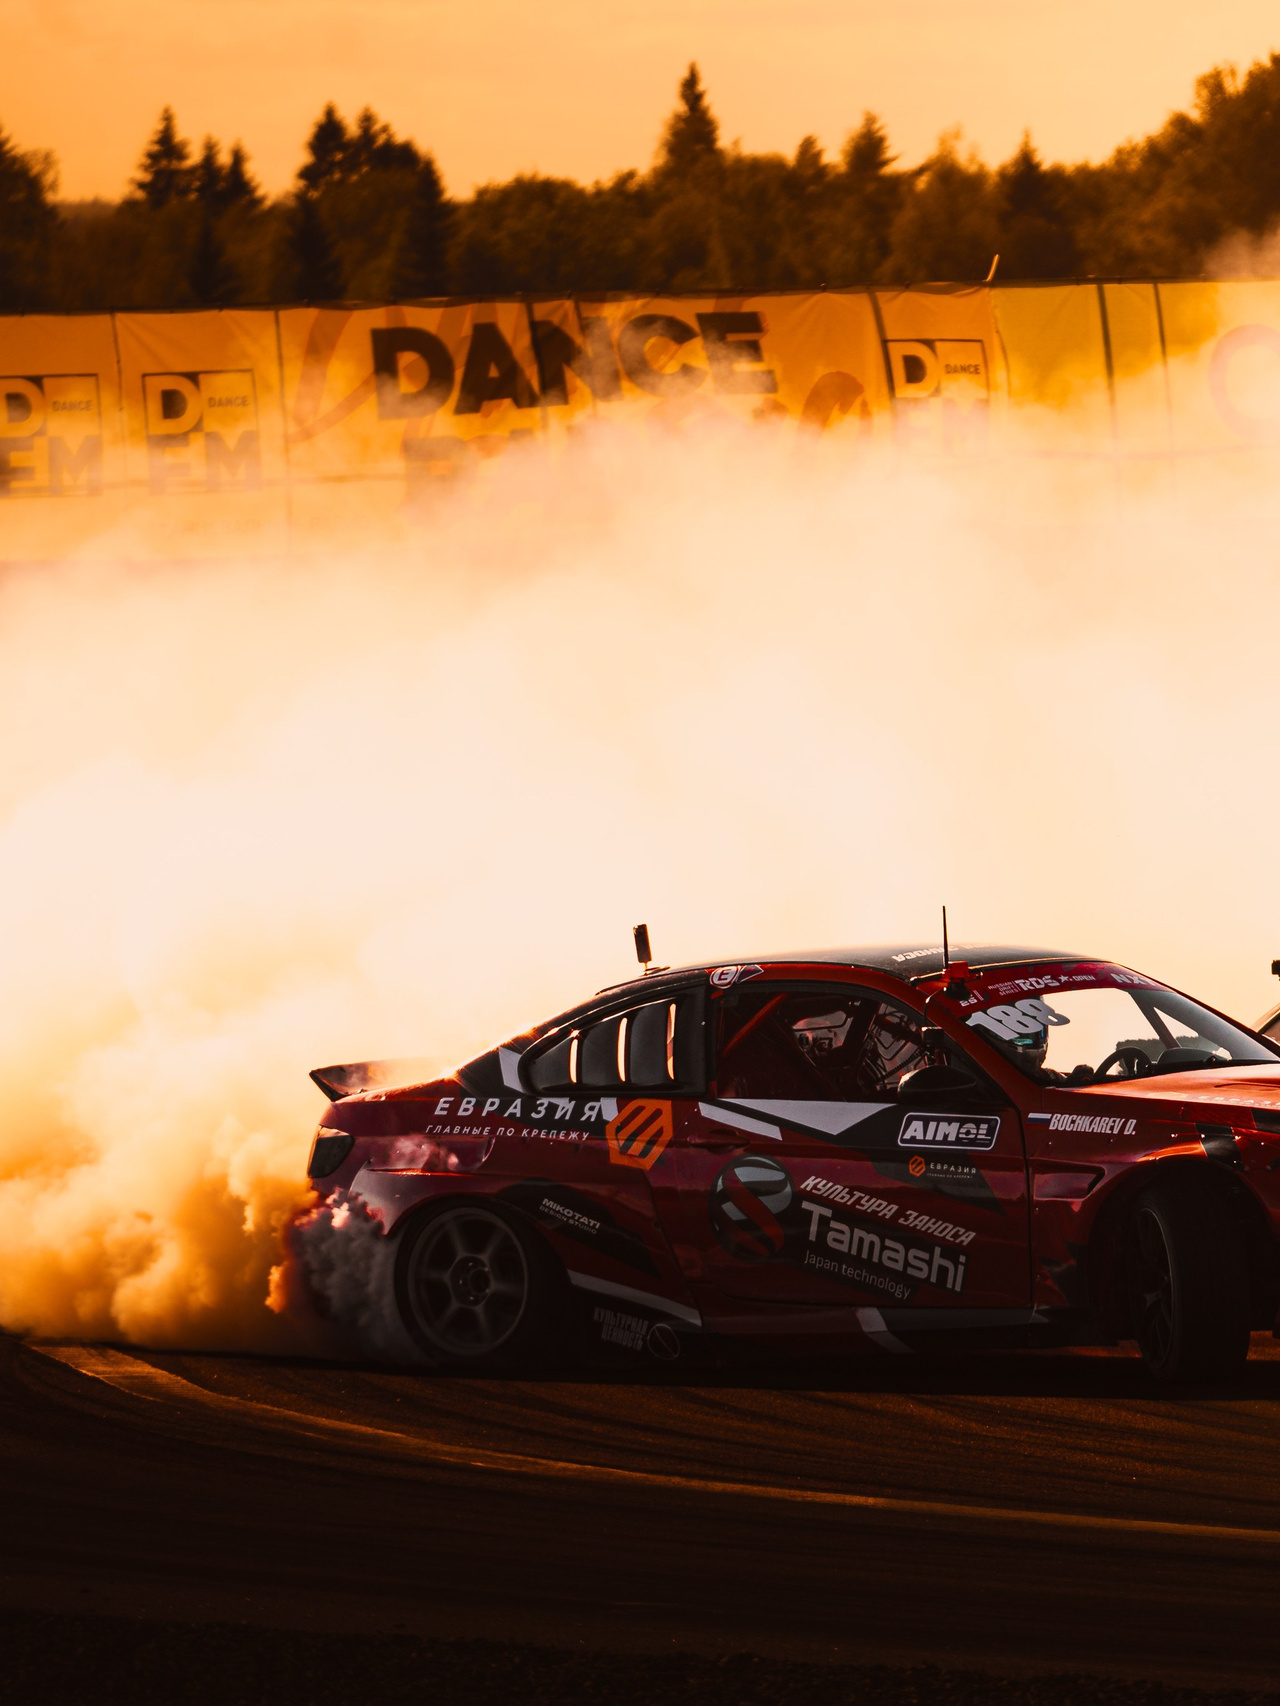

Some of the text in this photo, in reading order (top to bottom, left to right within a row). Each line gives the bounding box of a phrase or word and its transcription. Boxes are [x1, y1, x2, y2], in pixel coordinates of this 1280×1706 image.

[370, 311, 779, 420] DANCE
[944, 363, 982, 375] DANCE
[52, 400, 93, 413] DANCE
[208, 395, 249, 408] DANCE
[1015, 977, 1060, 991] RDS
[965, 998, 1071, 1041] 188
[434, 1097, 602, 1122] ЕВРАЗИЯ
[425, 1125, 590, 1141] ГЛАВНЫЕ ПО КРЕПЕЖУ
[902, 1120, 991, 1143] AIMOL
[1049, 1113, 1137, 1135] BOCHKAREV D.
[930, 1162, 977, 1174] ЕВРАЗИЯ
[539, 1205, 597, 1234] DESIGN STUDIO
[542, 1198, 600, 1229] MIKOTATI
[800, 1175, 976, 1246] КУЛЬТУРА ЗАНОСА
[801, 1200, 966, 1292] Tamashi
[804, 1250, 911, 1300] Japan technology
[593, 1306, 649, 1335] КУЛЬТУРНАЯ
[601, 1323, 643, 1351] ЦЕННОСТЬ
